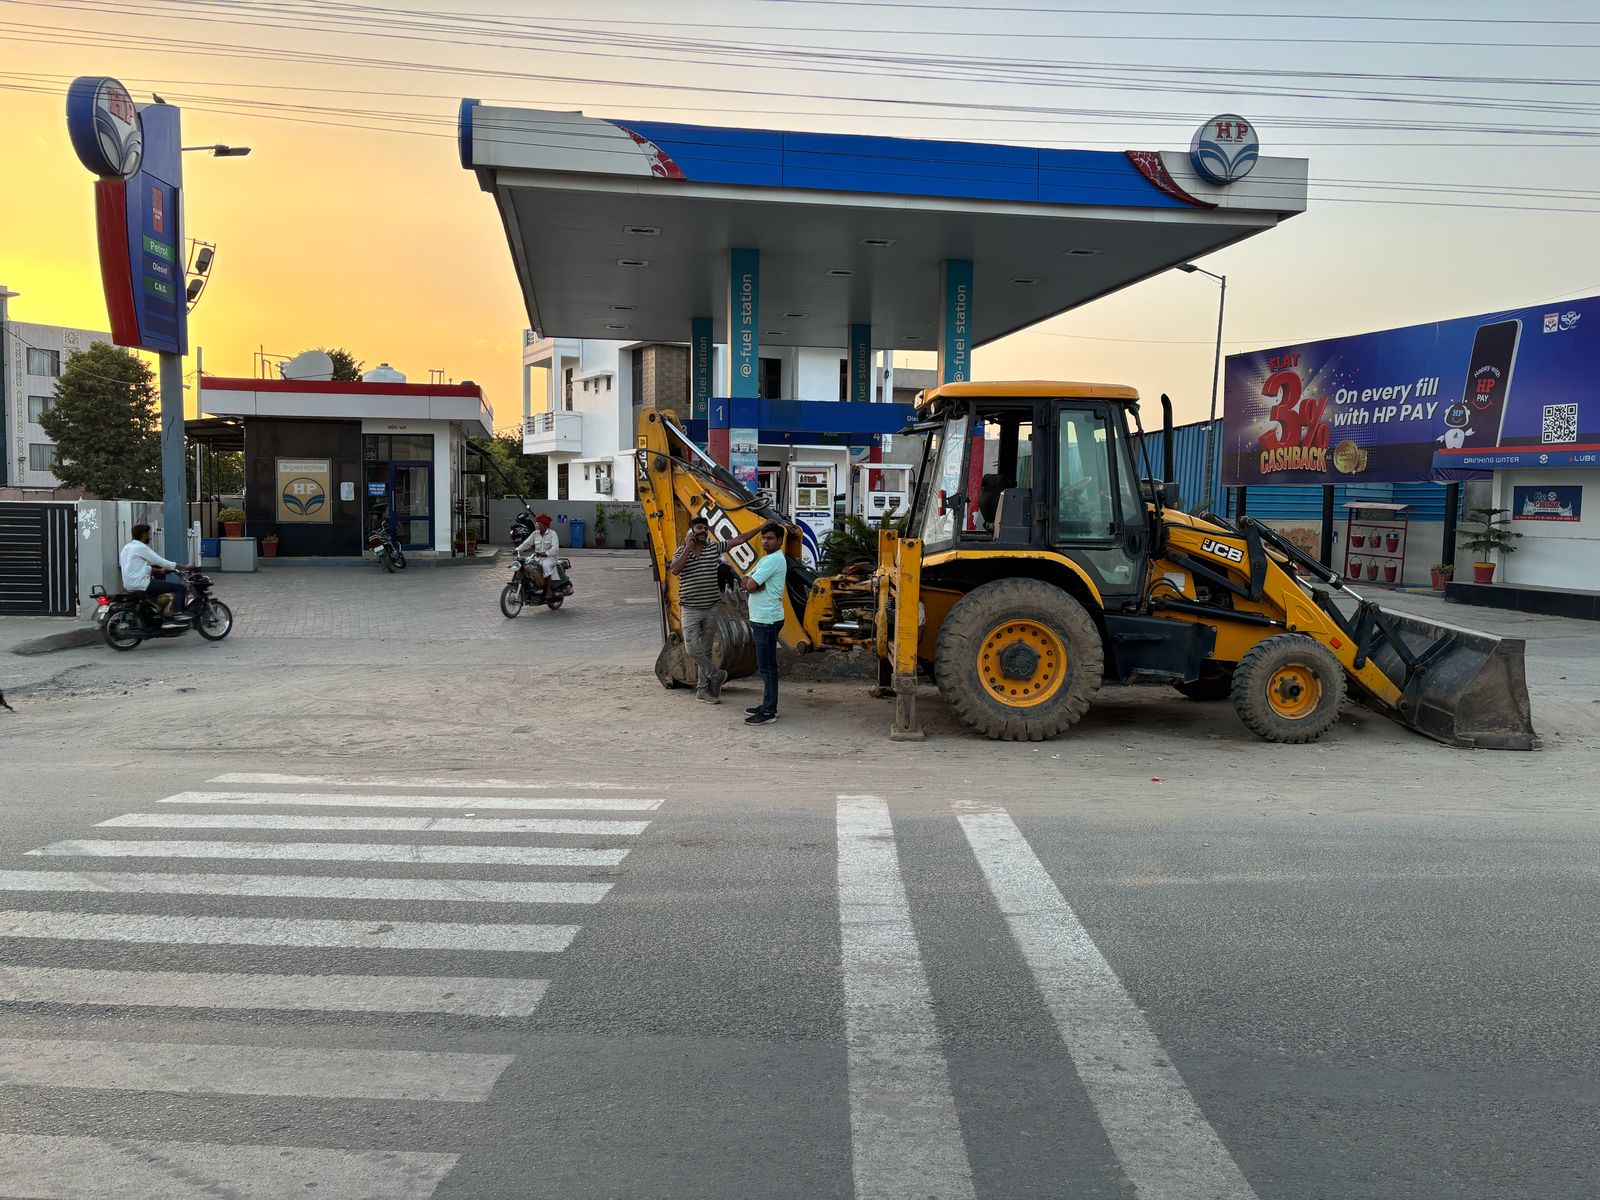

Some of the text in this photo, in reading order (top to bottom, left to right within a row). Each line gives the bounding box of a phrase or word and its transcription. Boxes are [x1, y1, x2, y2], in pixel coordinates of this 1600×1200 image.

[1215, 121, 1248, 142] HP
[150, 241, 168, 257] Petrol
[152, 262, 168, 275] Diesel
[740, 274, 752, 378] @-fuel station
[953, 285, 967, 382] @-fuel station
[857, 343, 867, 402] fuel station
[1268, 352, 1300, 373] FLAT
[698, 336, 708, 412] @-fuel station
[1335, 377, 1440, 405] On every fill
[1477, 379, 1495, 393] HP
[1476, 394, 1489, 402] PAY
[716, 405, 723, 421] 1
[1259, 371, 1329, 449] 3%
[1334, 402, 1439, 427] with HP PAY
[1452, 409, 1464, 417] HP
[1260, 446, 1328, 475] CASHBACK
[293, 483, 317, 495] HP
[701, 507, 755, 570] JCB
[1202, 540, 1243, 562] JCB
